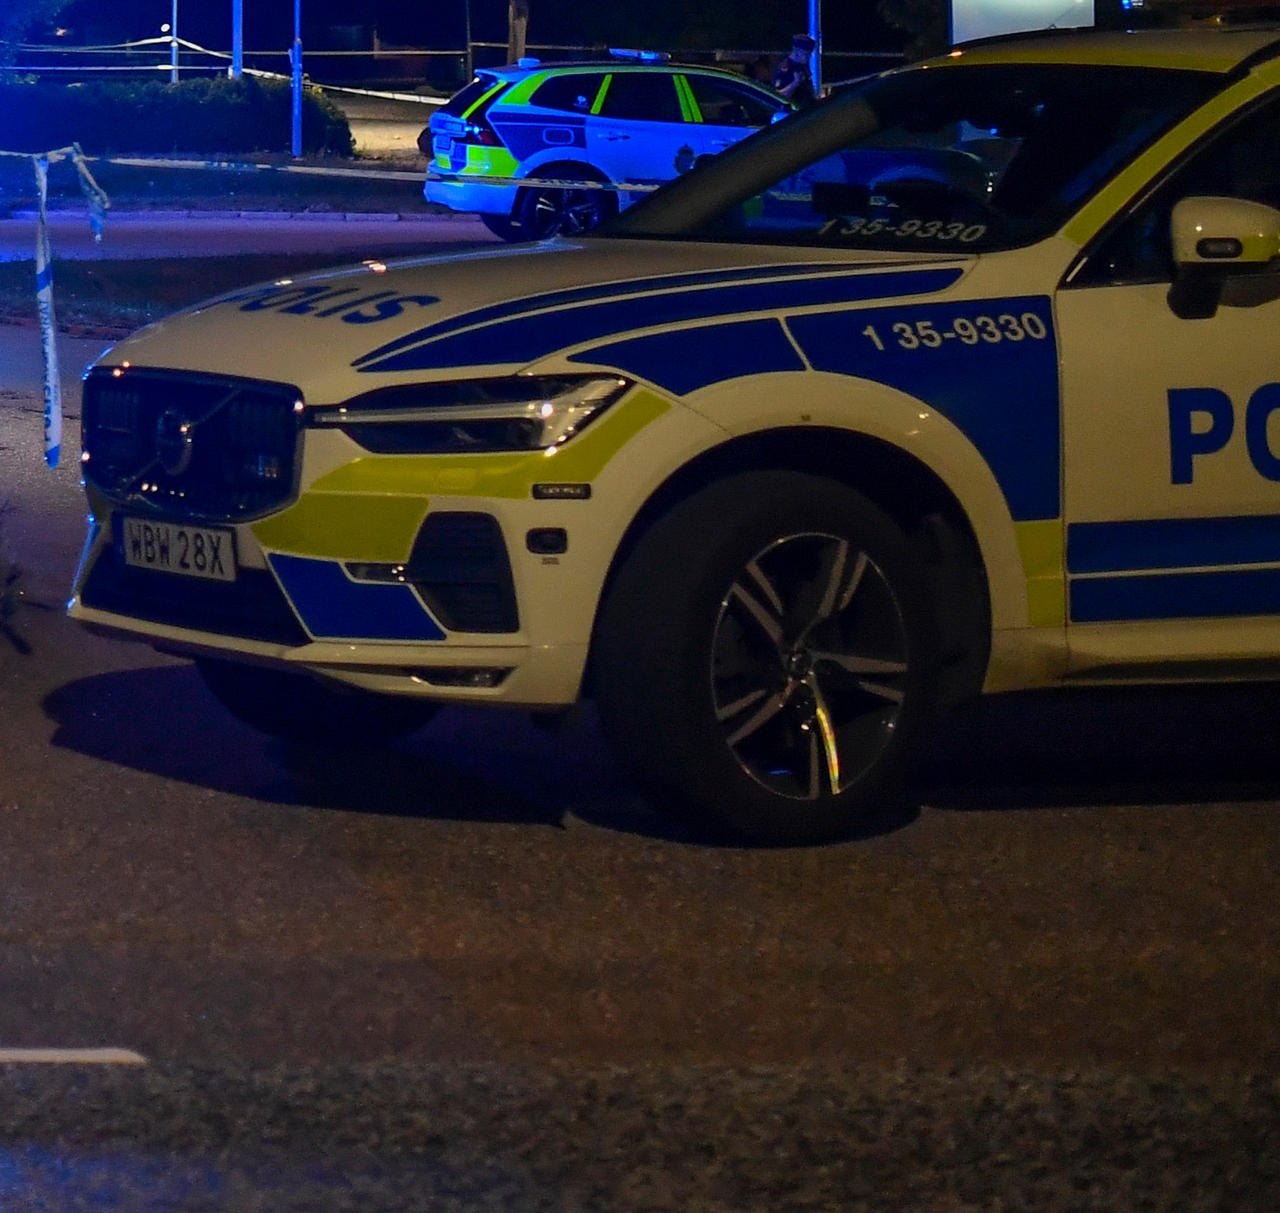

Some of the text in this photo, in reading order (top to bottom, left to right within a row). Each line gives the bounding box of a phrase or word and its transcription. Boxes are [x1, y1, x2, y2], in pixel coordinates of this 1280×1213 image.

[841, 218, 987, 243] 35-9330
[862, 311, 1047, 351] 1 35-9330
[127, 522, 225, 575] WBW 28X
